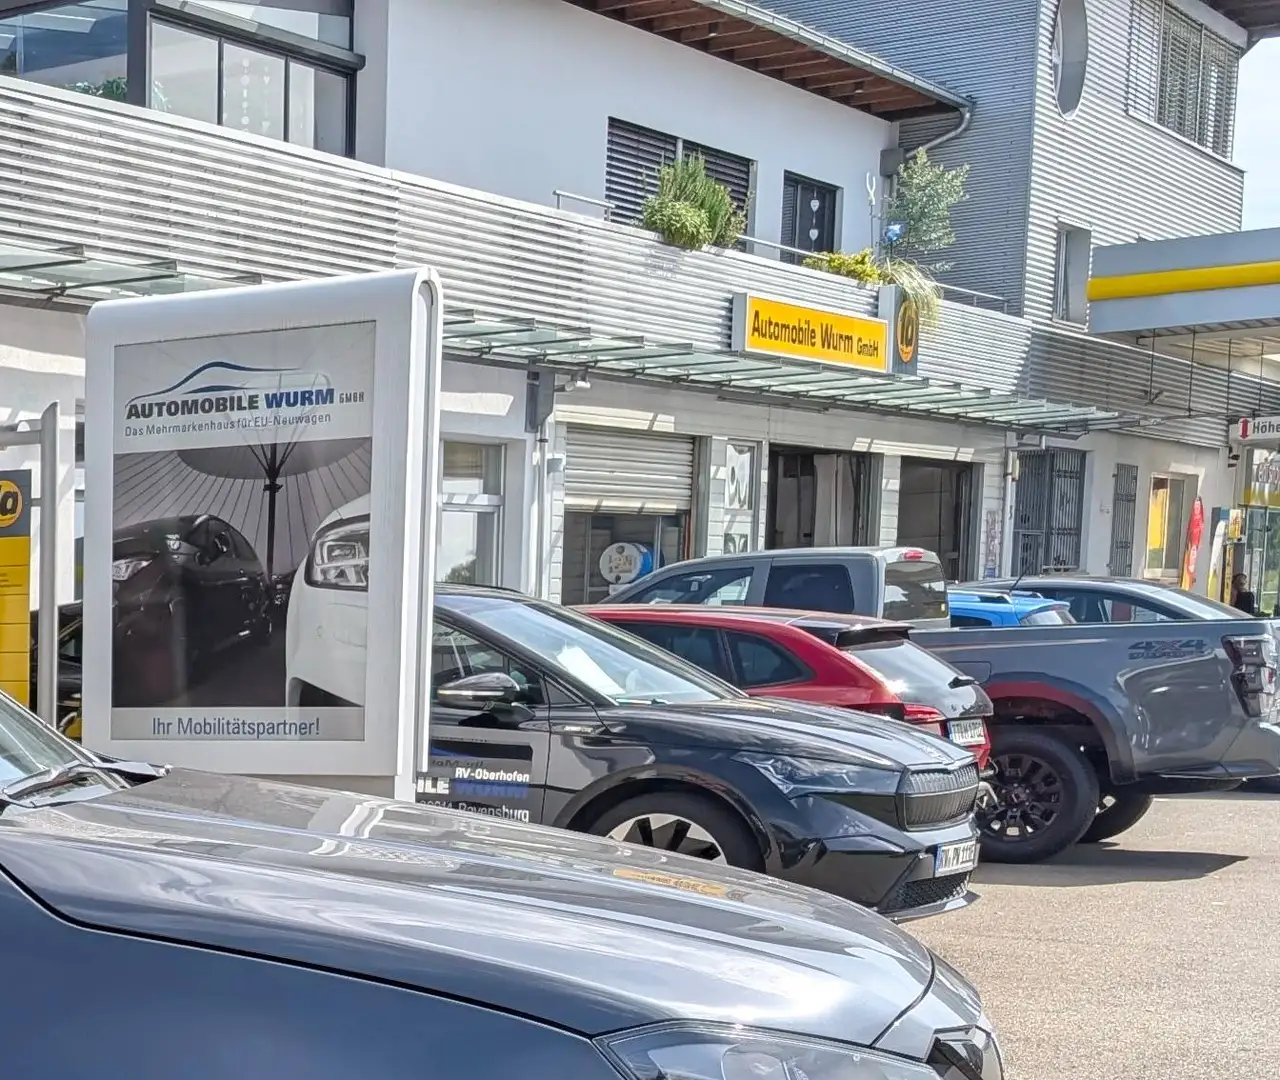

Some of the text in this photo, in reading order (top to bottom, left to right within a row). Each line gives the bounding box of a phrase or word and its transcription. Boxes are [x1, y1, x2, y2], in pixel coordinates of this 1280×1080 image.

[751, 309, 879, 359] Automobile Wurm GmbH
[125, 393, 260, 420] AUTOMOBILE
[264, 387, 335, 410] WURM
[124, 412, 331, 437] Das Mehrmarkenhaus für EU-Neuwagen
[152, 716, 320, 739] Ihr Mobilitätspartner!
